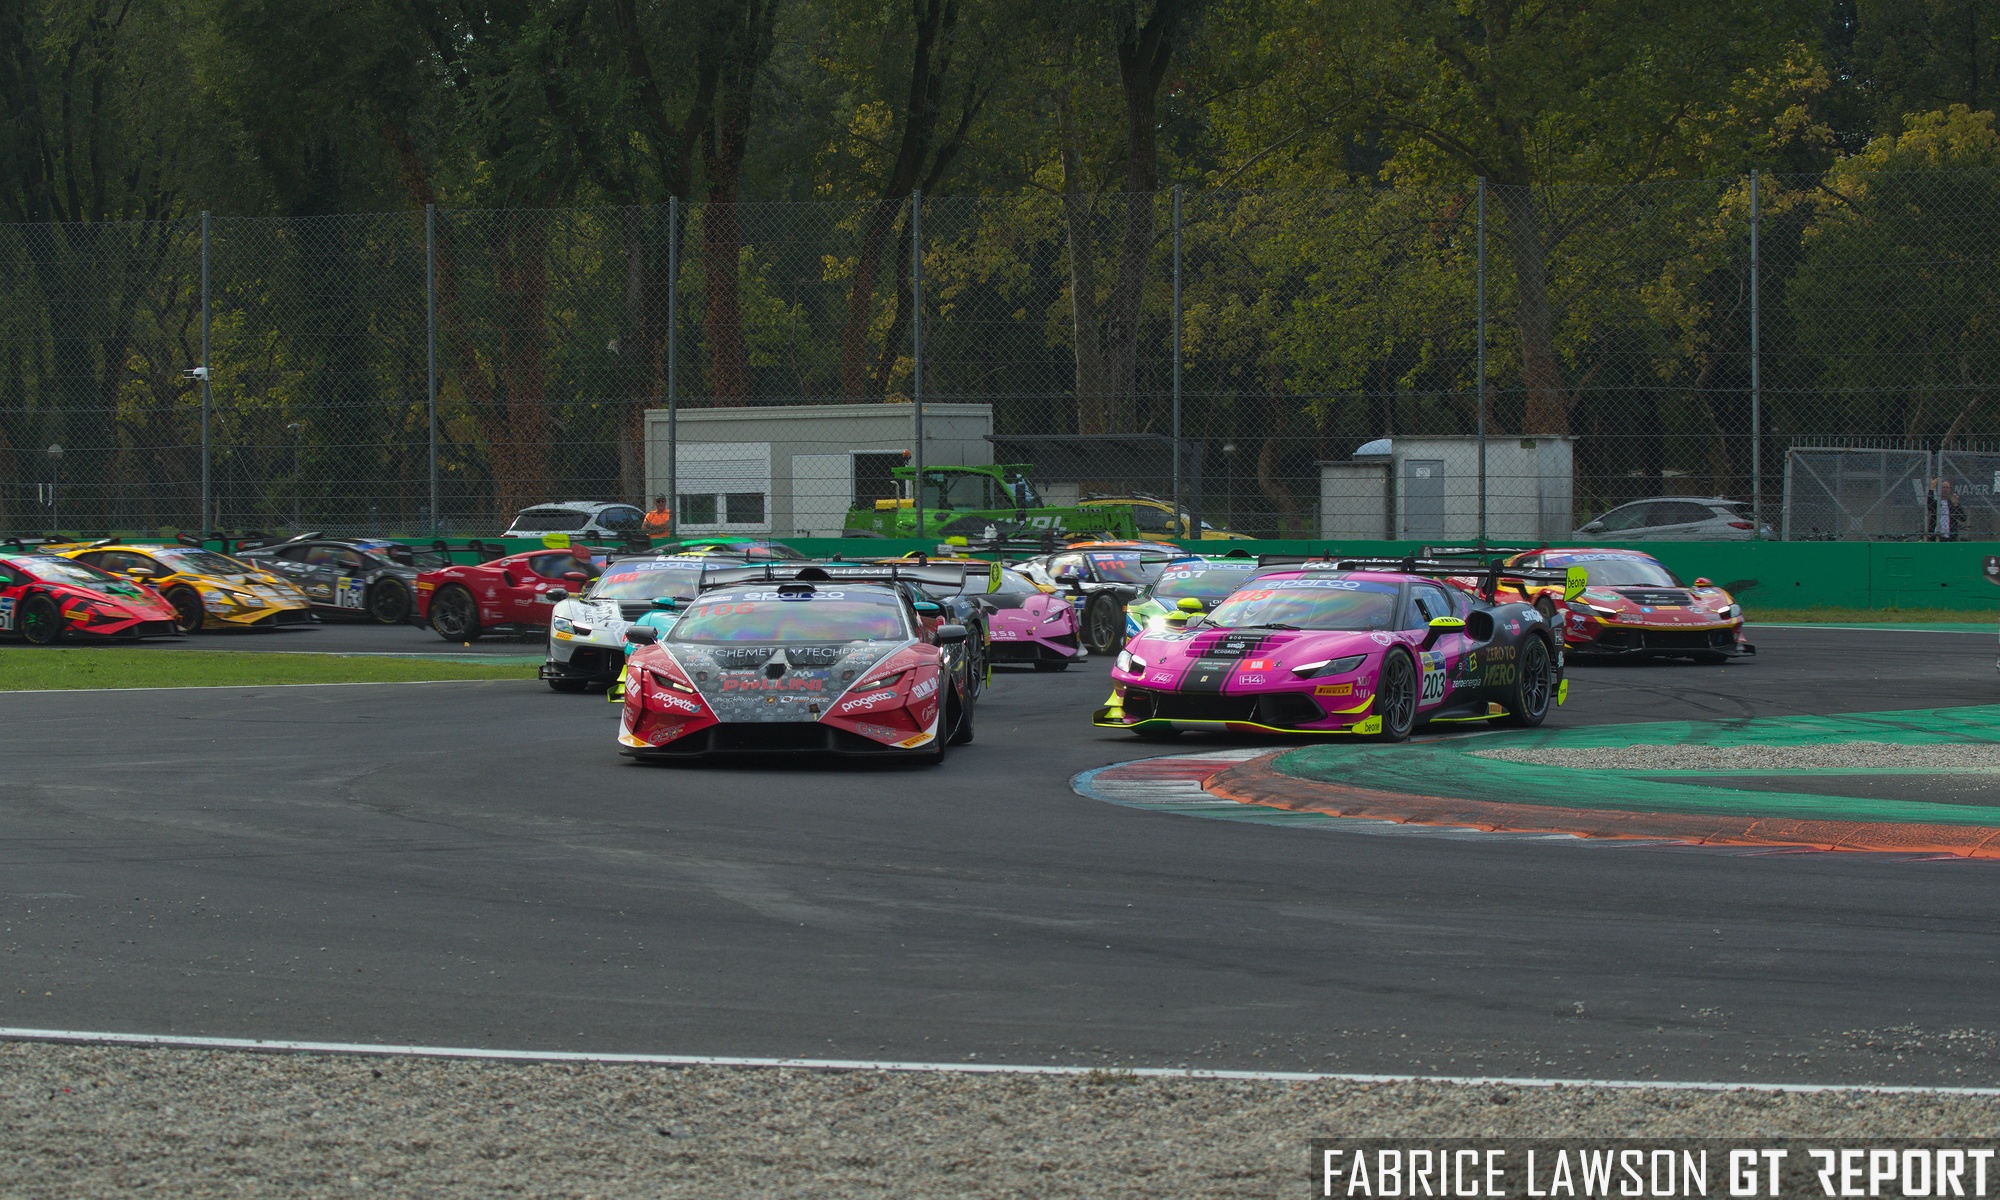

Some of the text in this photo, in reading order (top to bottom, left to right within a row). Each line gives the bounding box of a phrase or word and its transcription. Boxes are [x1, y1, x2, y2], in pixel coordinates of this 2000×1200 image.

[1096, 560, 1126, 571] 111
[606, 571, 639, 585] 188
[1161, 570, 1206, 582] 207
[1264, 579, 1360, 590] sparco
[743, 591, 845, 601] sparco
[1225, 590, 1274, 603] 203
[695, 602, 755, 617] 106
[1486, 645, 1516, 662] ZERO TO
[1250, 660, 1263, 669] AM
[1318, 686, 1350, 694] PIRELLI
[1422, 672, 1445, 700] 203
